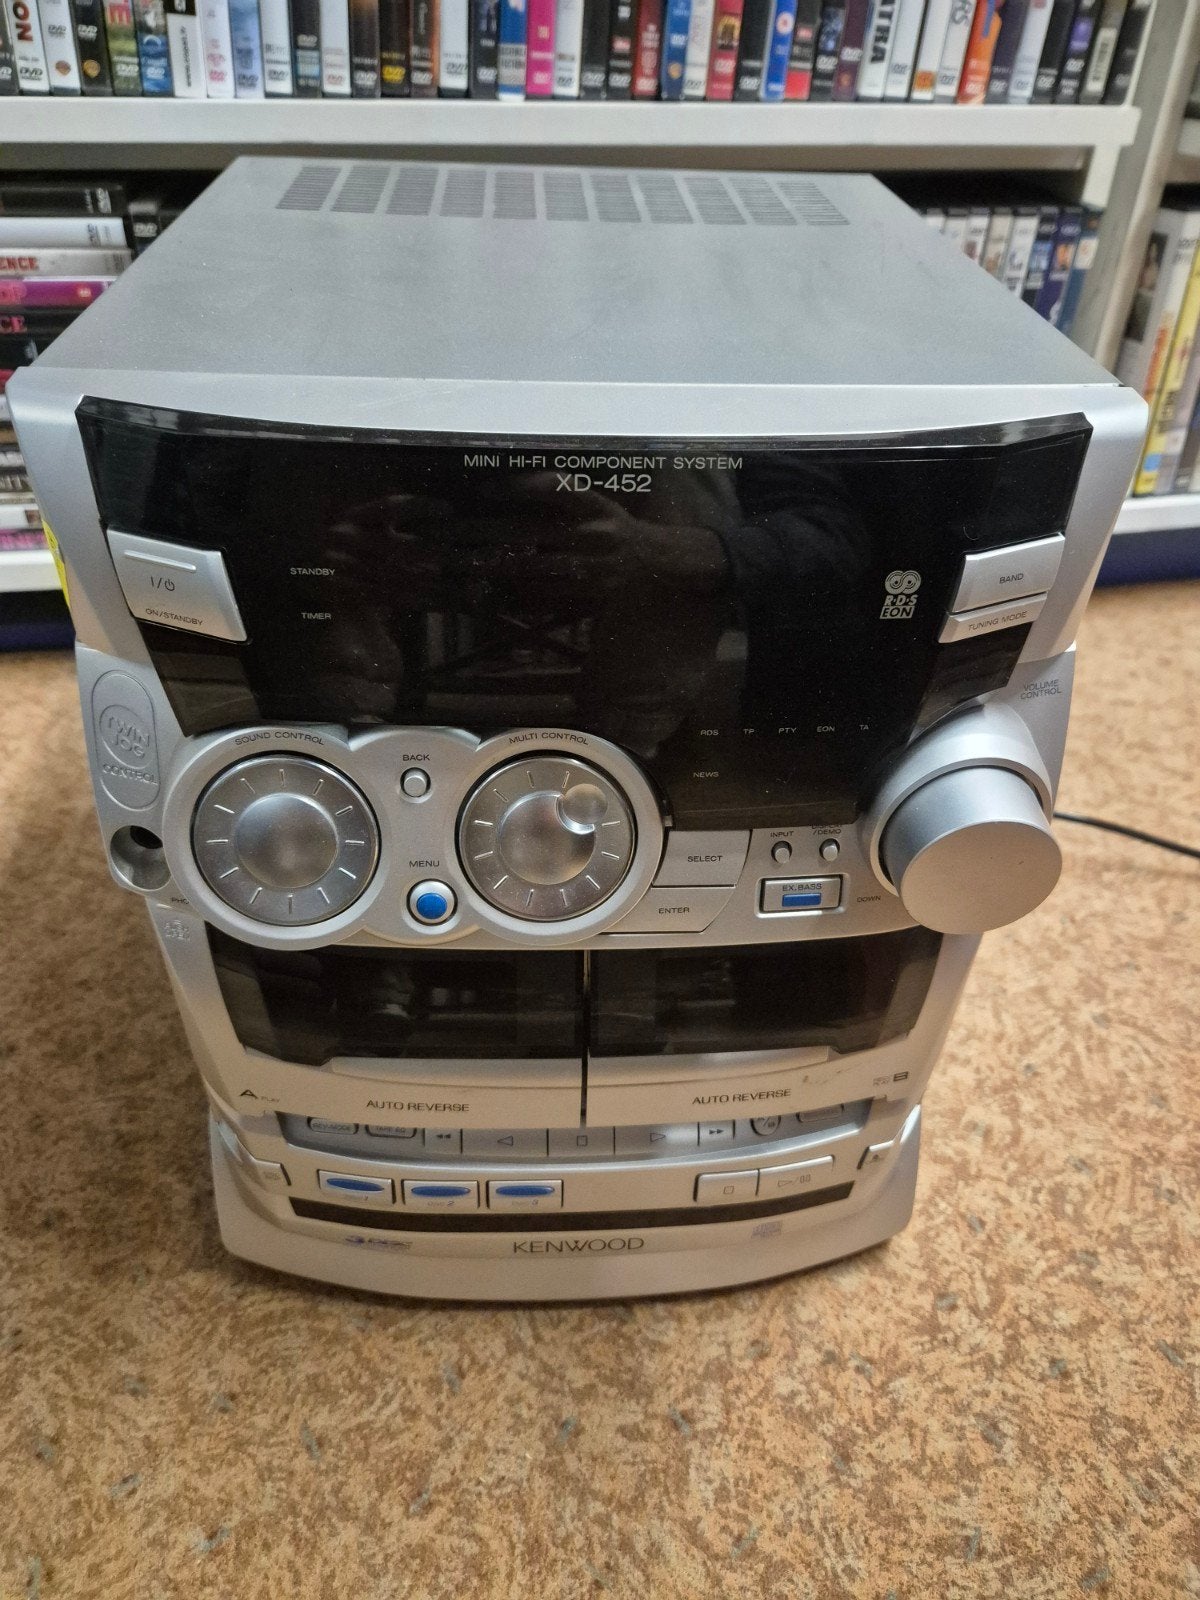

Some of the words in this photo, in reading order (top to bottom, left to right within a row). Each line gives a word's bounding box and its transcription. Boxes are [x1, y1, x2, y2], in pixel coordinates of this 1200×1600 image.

[870, 0, 896, 63] TRA
[463, 454, 500, 468] MINI
[509, 455, 546, 468] HI-FI
[554, 455, 667, 470] COMPONENT
[672, 456, 744, 470] SYSTEM
[555, 473, 652, 493] XD-452
[290, 567, 336, 577] STANDBY
[999, 572, 1024, 584] BAND
[145, 607, 203, 625] ON/STANDBY
[301, 612, 332, 620] TIMER
[881, 606, 914, 618] EON
[968, 619, 999, 632] TUNING
[1002, 611, 1028, 623] MODE
[1023, 679, 1059, 692] VOLUME
[1020, 687, 1062, 700] CONTROL
[816, 725, 835, 733] EON
[234, 731, 271, 746] SOUND
[274, 731, 325, 746] CONTROL
[508, 733, 538, 745] MULTI
[541, 732, 589, 746] CONTROL
[402, 754, 430, 762] BACK
[102, 764, 159, 785] CONTROL
[408, 860, 440, 868] MENU
[687, 855, 722, 863] SELECT
[782, 883, 822, 892] EX.BASS
[856, 895, 881, 903] DOWN
[893, 1071, 909, 1082] B
[239, 1089, 258, 1099] A
[692, 1094, 729, 1105] AUTO
[732, 1088, 792, 1102] REVERSE
[366, 1099, 403, 1110] AUTO
[408, 1103, 470, 1113] REVERSE
[512, 1237, 645, 1254] KENWOOD
